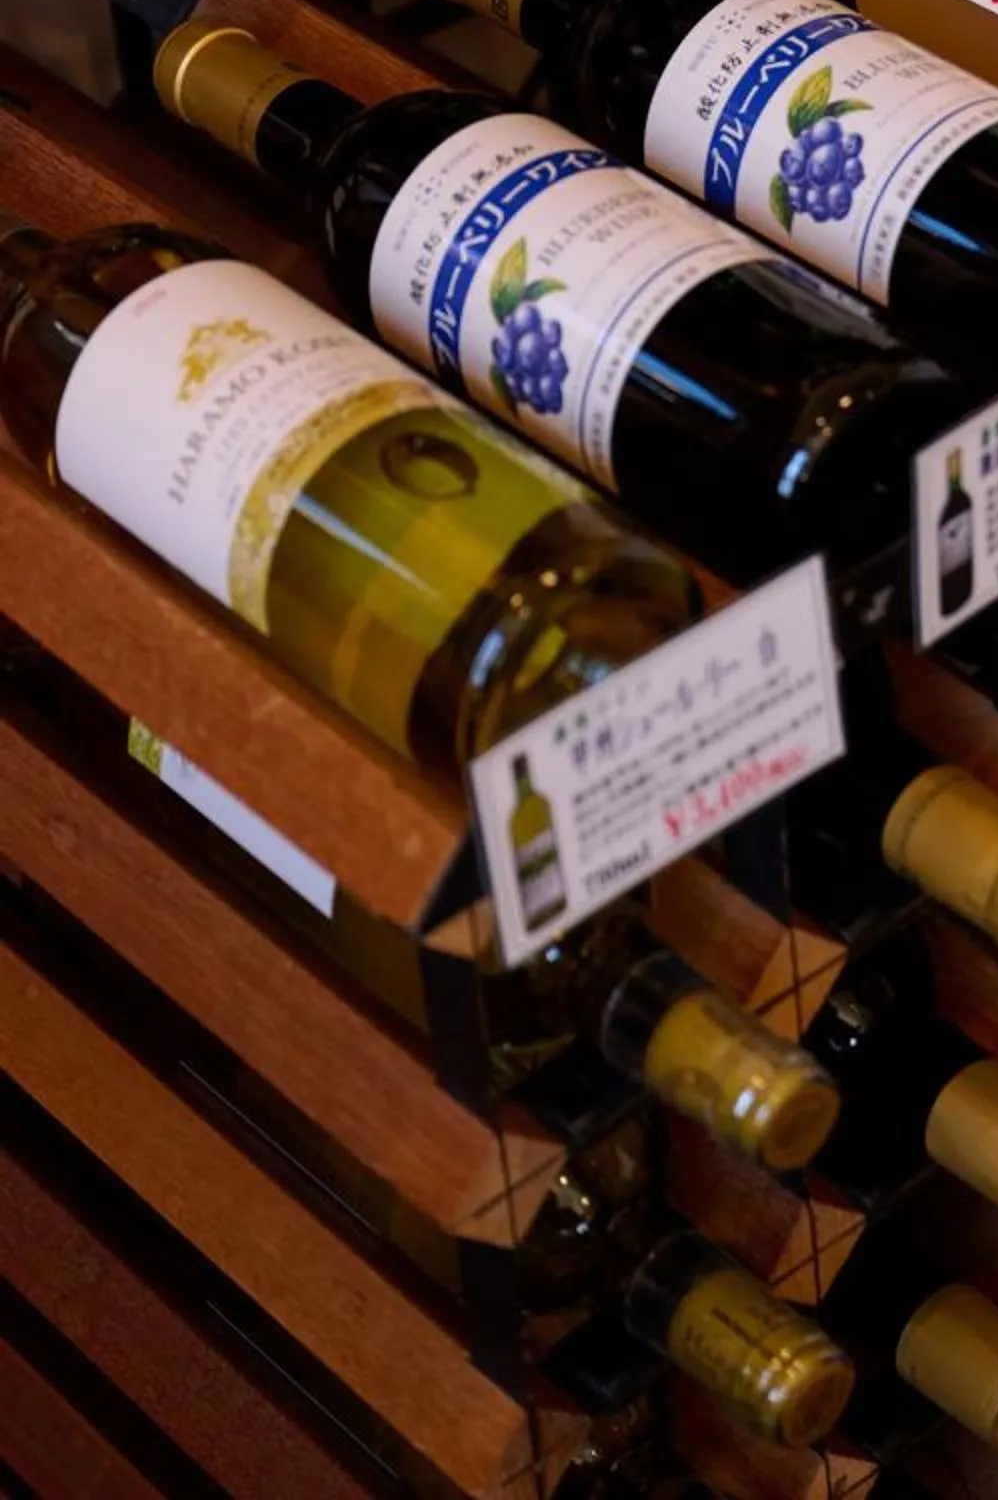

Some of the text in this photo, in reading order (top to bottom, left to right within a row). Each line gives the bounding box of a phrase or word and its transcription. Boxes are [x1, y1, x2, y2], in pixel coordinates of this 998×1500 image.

[709, 13, 873, 188] ブルーベリーワ
[166, 360, 268, 506] HARAMO
